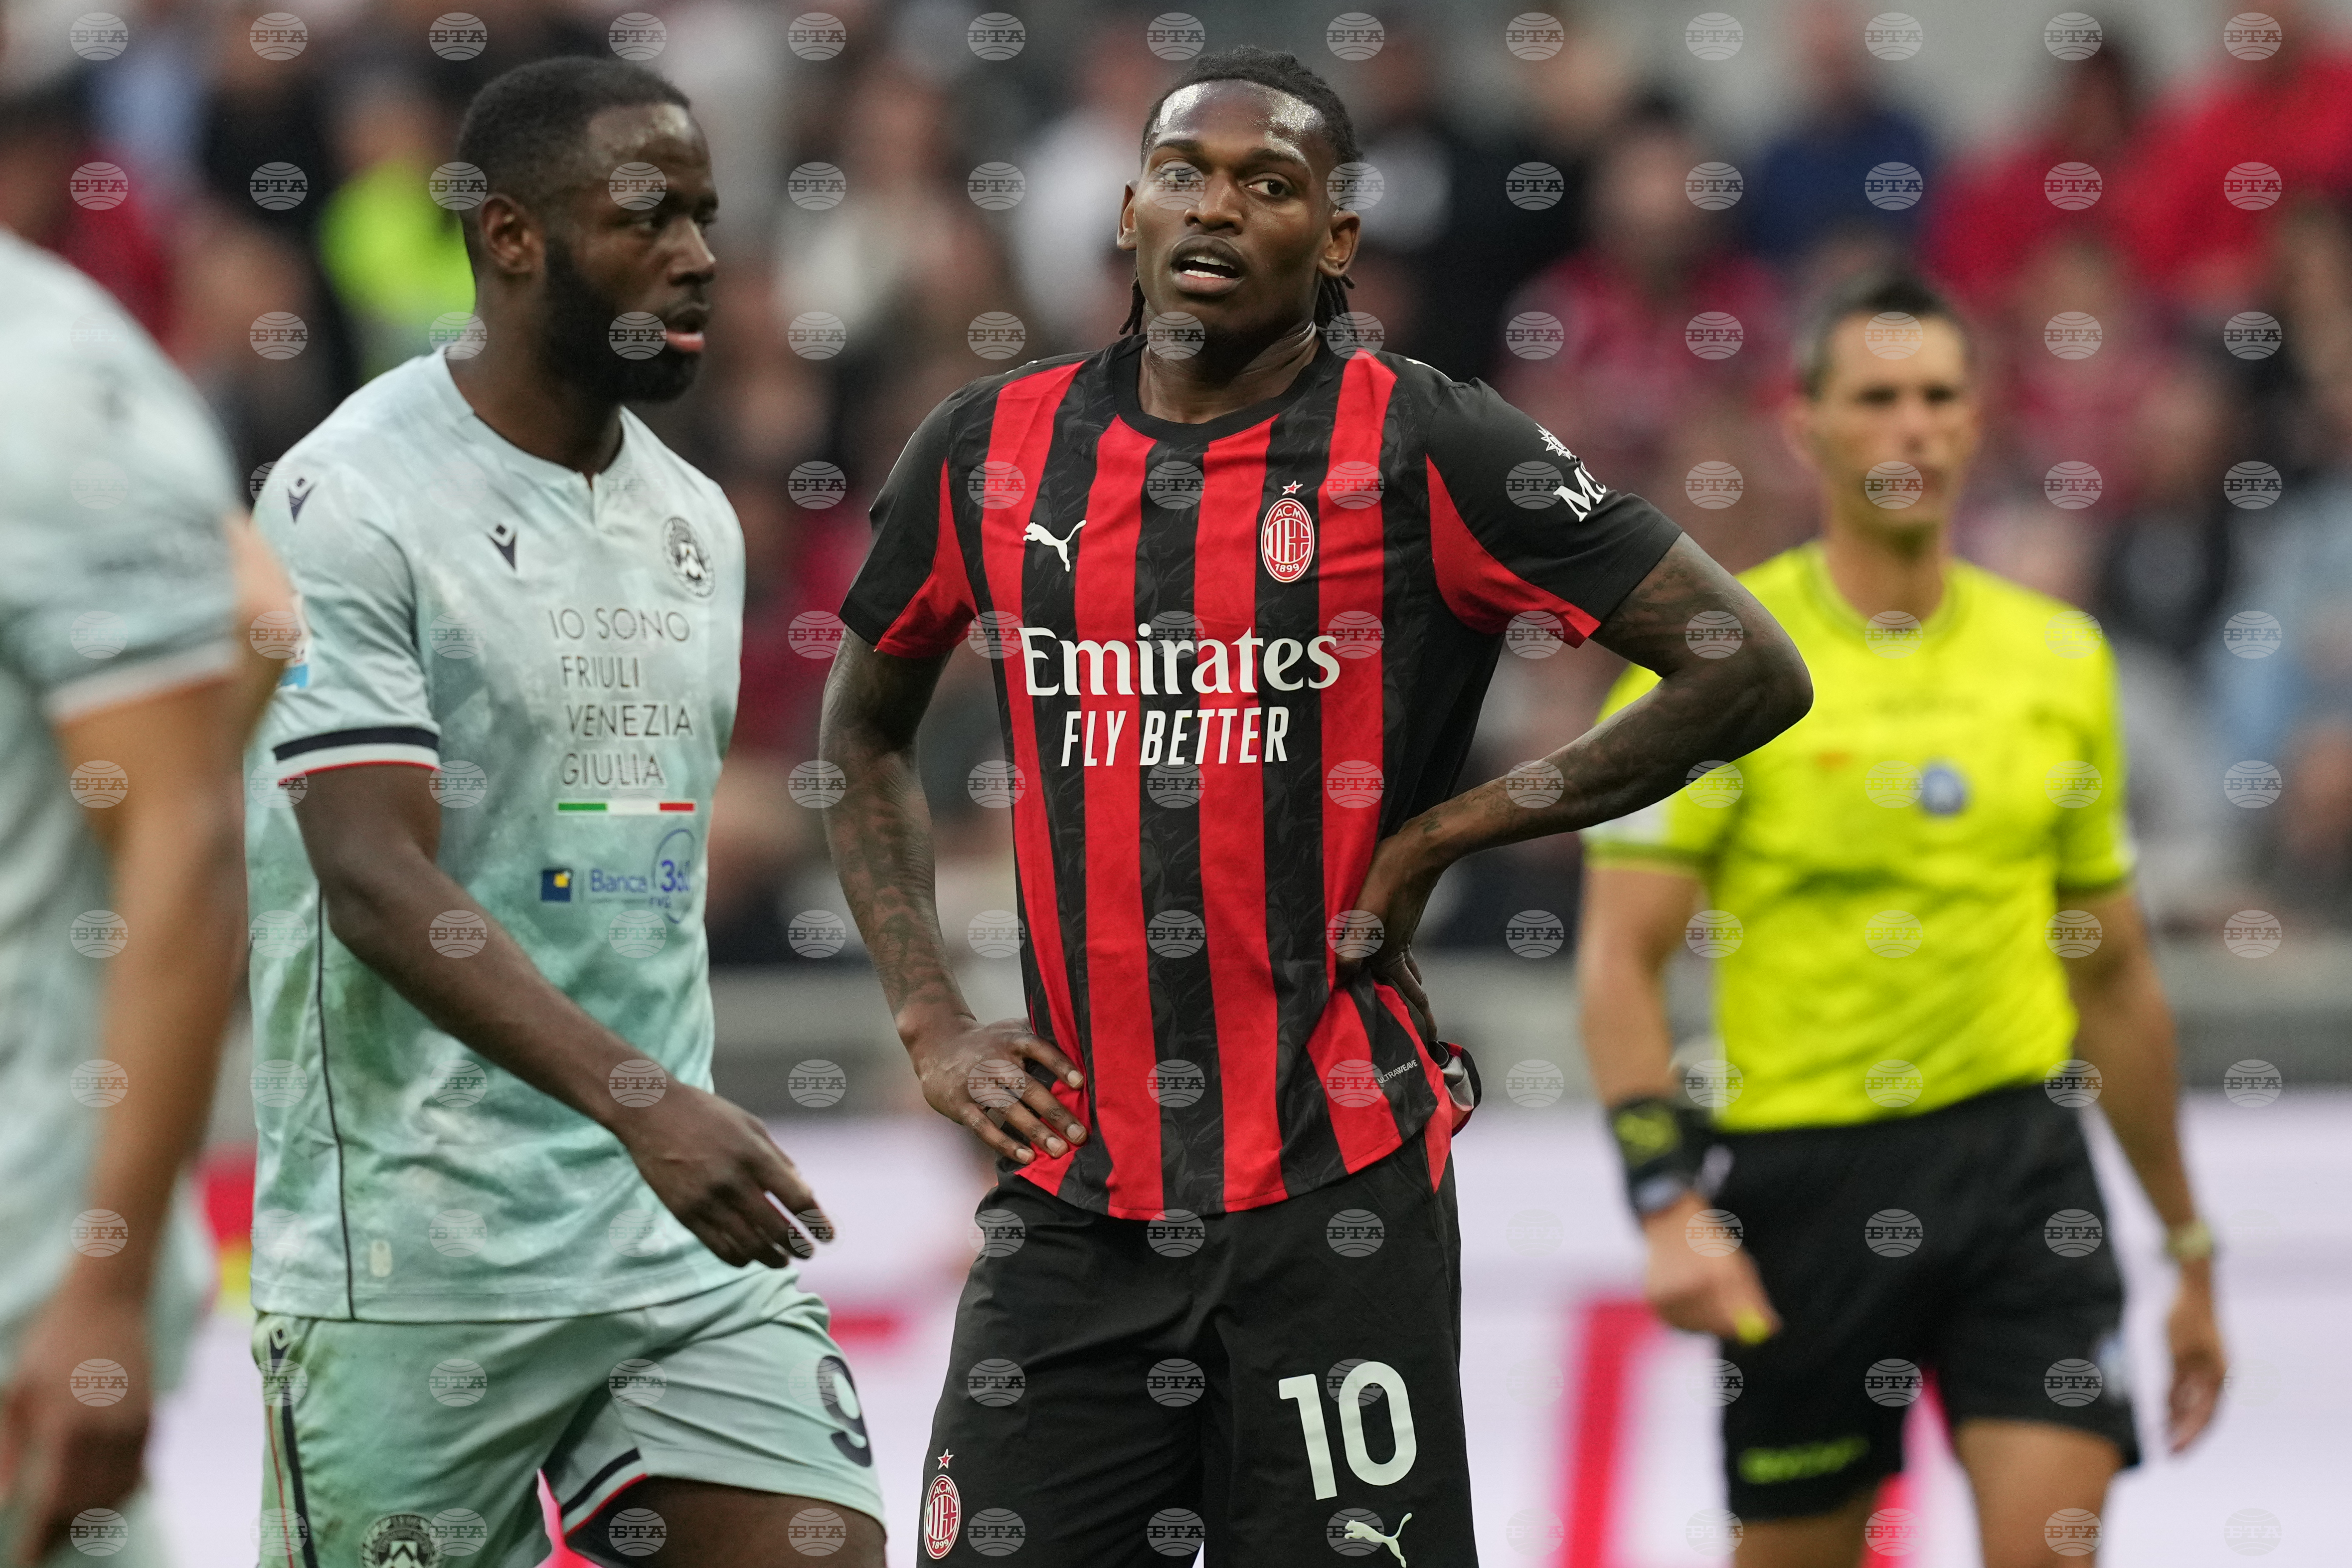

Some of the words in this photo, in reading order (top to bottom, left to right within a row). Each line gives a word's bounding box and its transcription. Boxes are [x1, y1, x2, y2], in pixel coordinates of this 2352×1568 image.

[1273, 505, 1303, 522] ACM
[1275, 563, 1300, 573] 1899
[549, 609, 585, 640] IO
[596, 607, 690, 642] SONO
[561, 656, 640, 688] FRIULI
[1016, 623, 1340, 696] Emirates
[567, 704, 693, 736] VENEZIA
[1060, 710, 1127, 767] FLY
[1139, 706, 1290, 766] BETTER
[561, 752, 665, 785] GIULIA
[1377, 1059, 1418, 1084] ULTRAWEAVE
[816, 1355, 872, 1468] 9
[1278, 1361, 1417, 1501] 10
[932, 1481, 953, 1499] ACM
[932, 1539, 949, 1550] 1899
